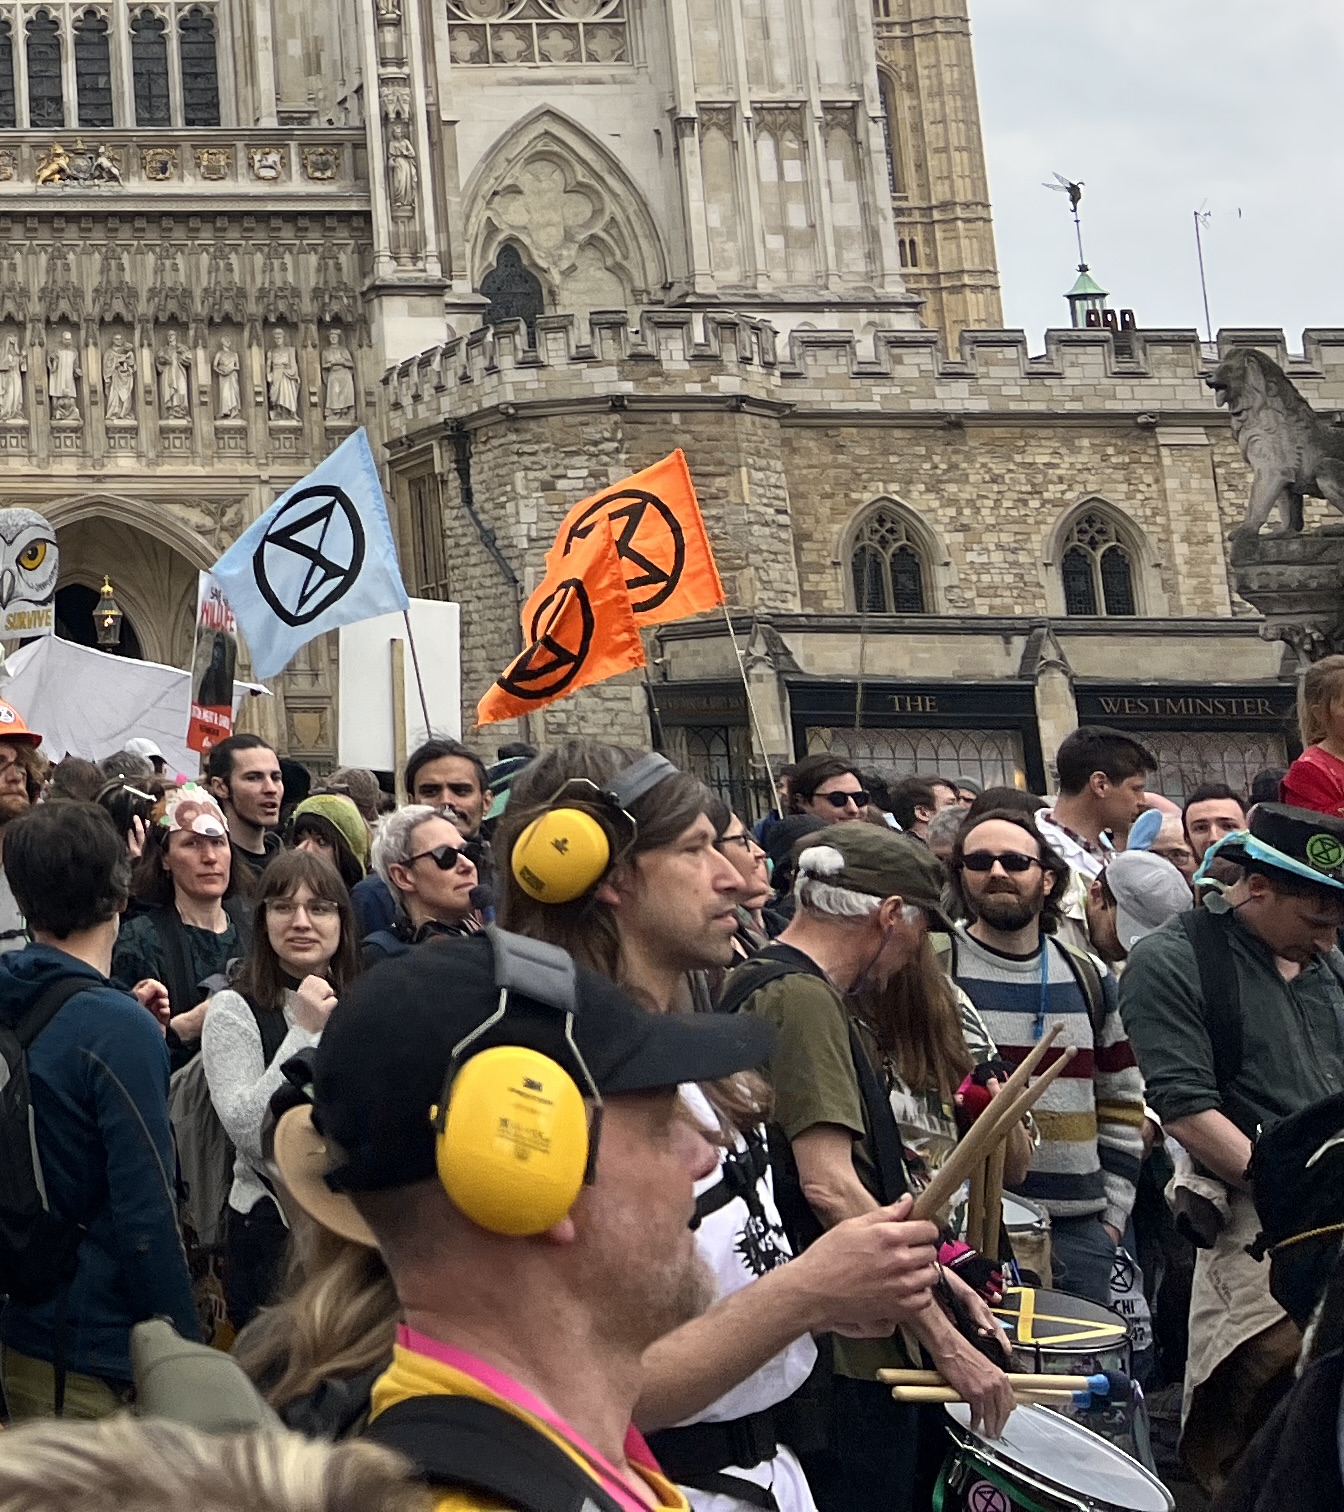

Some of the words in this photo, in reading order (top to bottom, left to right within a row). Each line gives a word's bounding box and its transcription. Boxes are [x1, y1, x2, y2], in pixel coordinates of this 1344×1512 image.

[4, 608, 53, 632] SURVIVE
[887, 694, 939, 712] THE
[1098, 697, 1276, 716] WESTMINSTER
